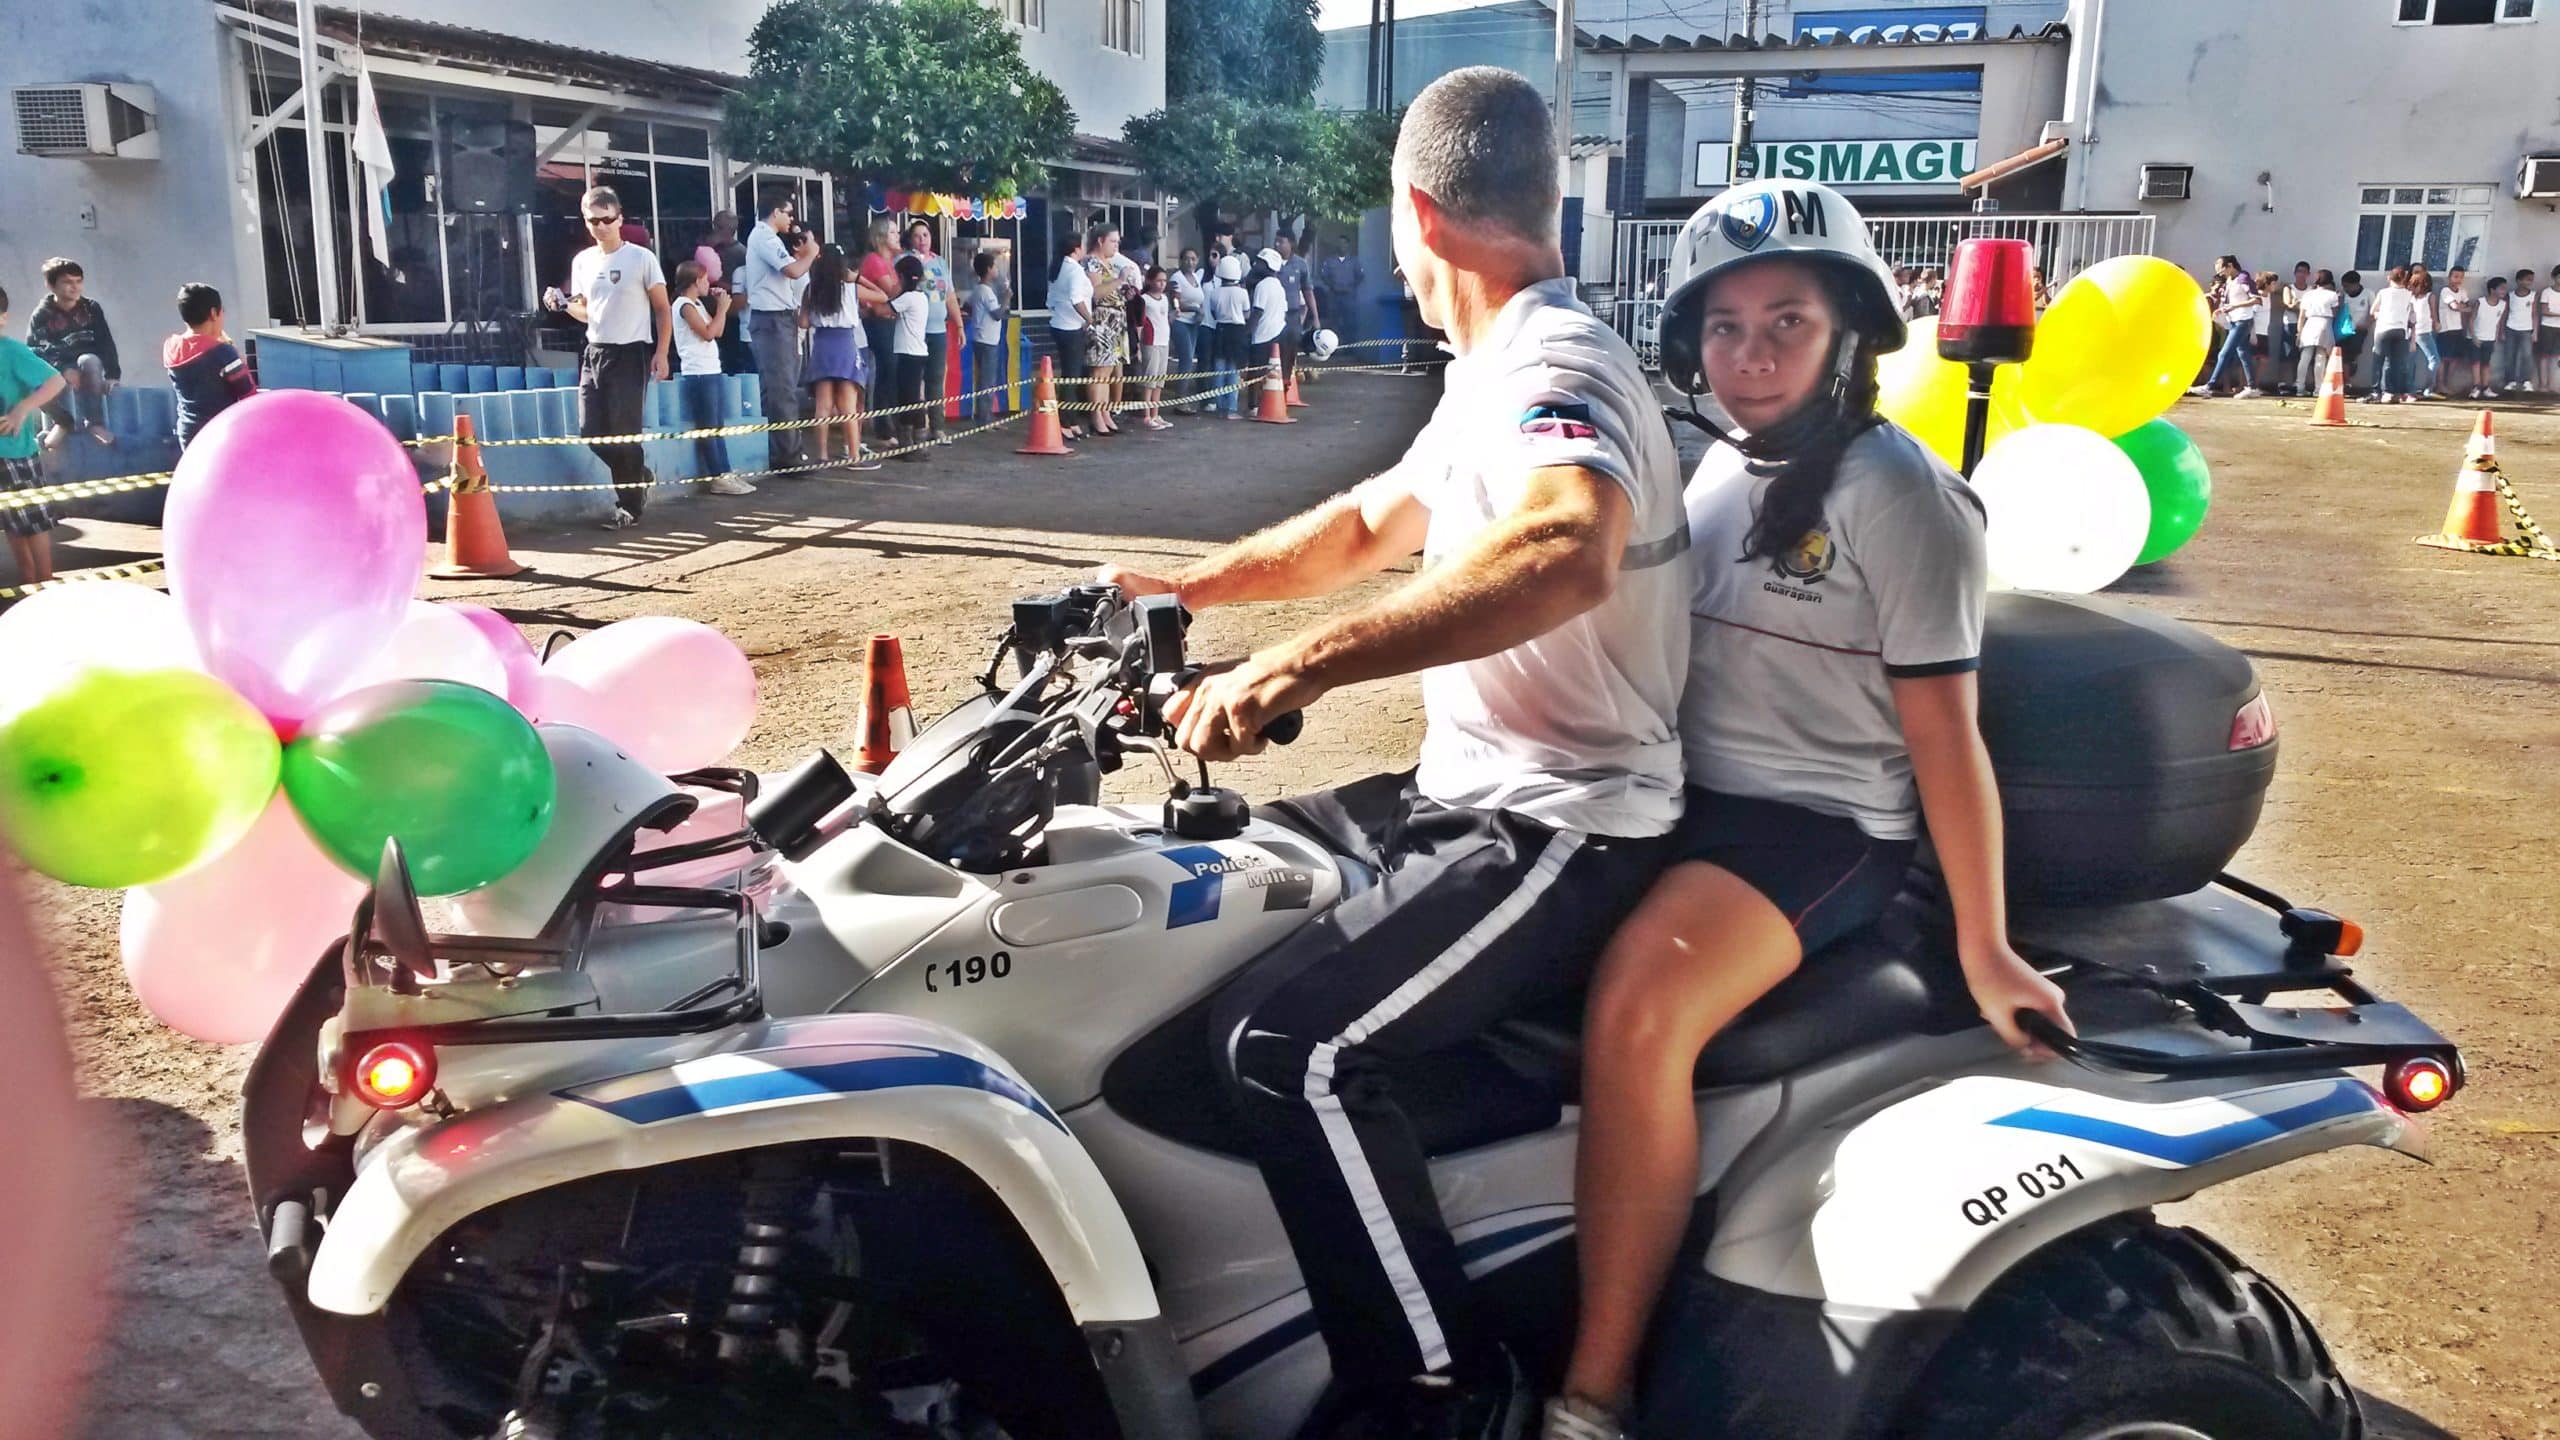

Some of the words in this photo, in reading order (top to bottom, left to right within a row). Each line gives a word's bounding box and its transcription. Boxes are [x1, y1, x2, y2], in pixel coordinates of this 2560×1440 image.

[1781, 189, 1828, 238] M
[1763, 582, 1823, 604] Guarapari
[1246, 869, 1311, 889] Milia
[945, 951, 1011, 987] 190
[1961, 1186, 2008, 1226] QP
[2016, 1154, 2084, 1199] 031
